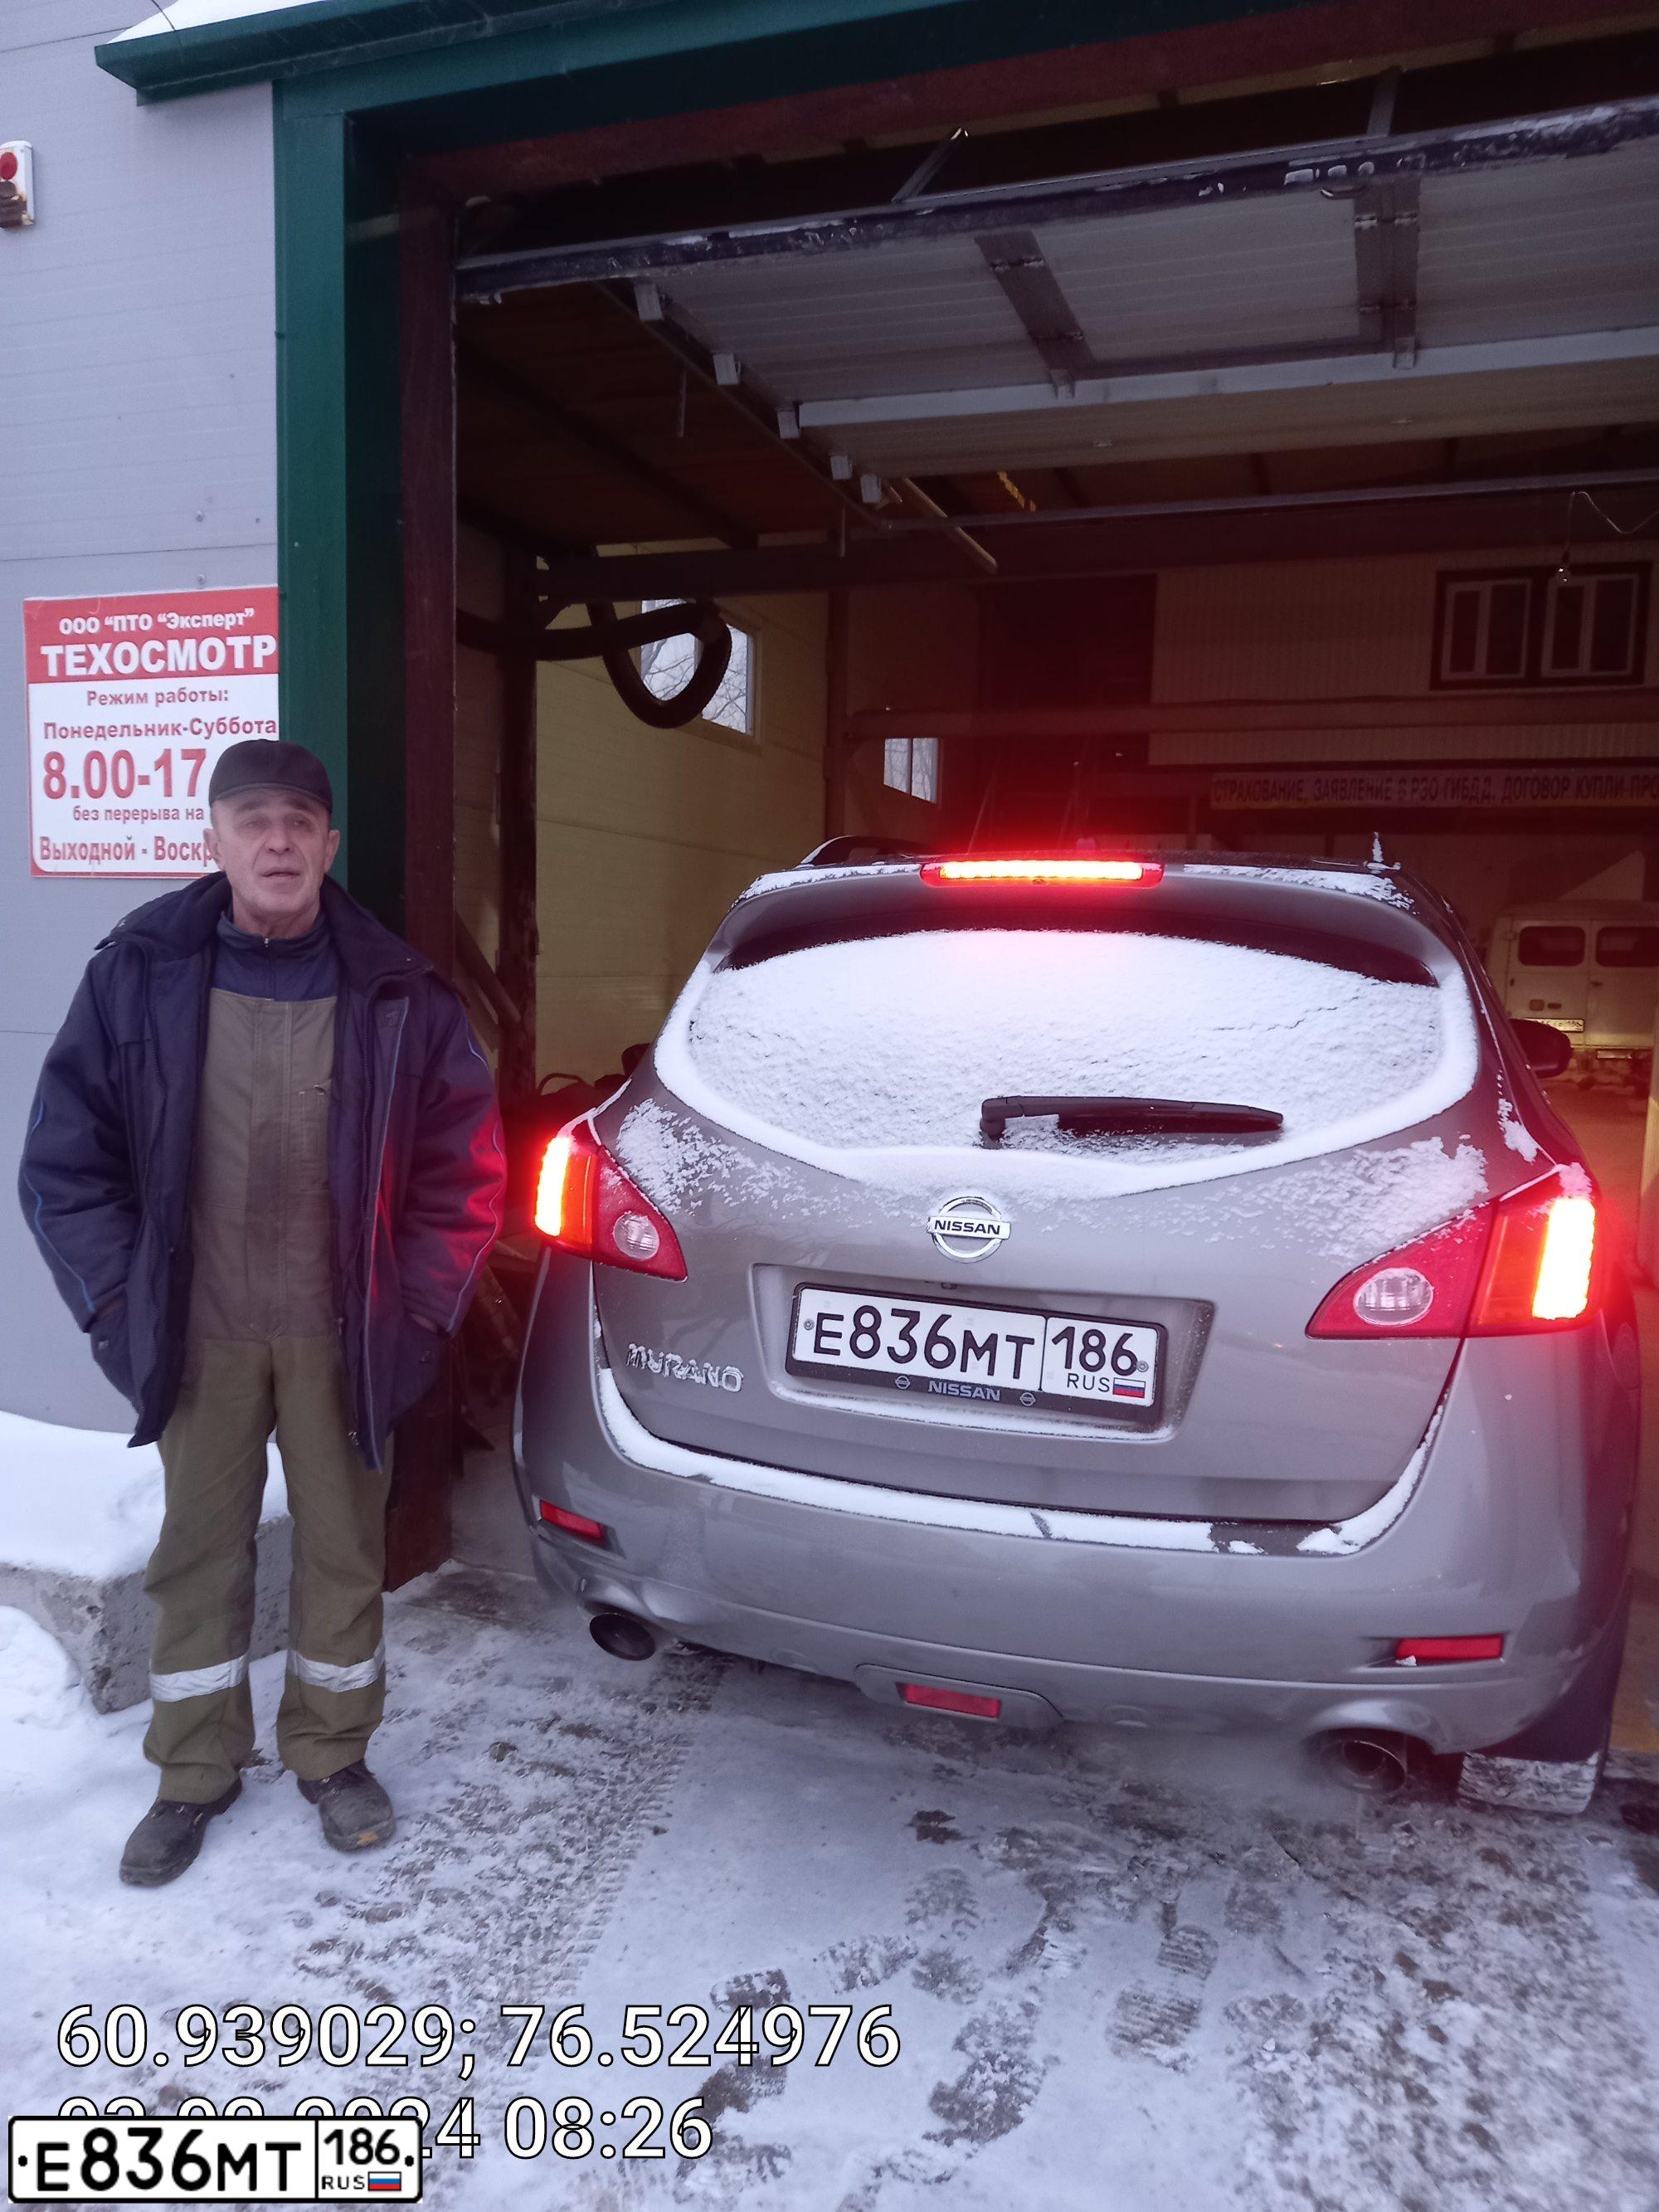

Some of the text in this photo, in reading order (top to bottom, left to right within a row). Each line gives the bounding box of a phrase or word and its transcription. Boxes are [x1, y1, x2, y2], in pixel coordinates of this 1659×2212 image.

[59, 616, 100, 635] ООО
[41, 635, 276, 677] ТЕХОСМОТР
[87, 687, 229, 707] Режим работы:
[44, 717, 276, 742] Понедельник-Суббота
[1501, 775, 1570, 805] ДОГОВОР
[73, 805, 204, 825] без перерыва на
[40, 835, 135, 865] Выходной
[934, 1220, 1000, 1235] NISSAN
[813, 1304, 1139, 1380] Е836МТ 186
[927, 1380, 1001, 1402] NISSAN
[1067, 1373, 1111, 1394] RUS
